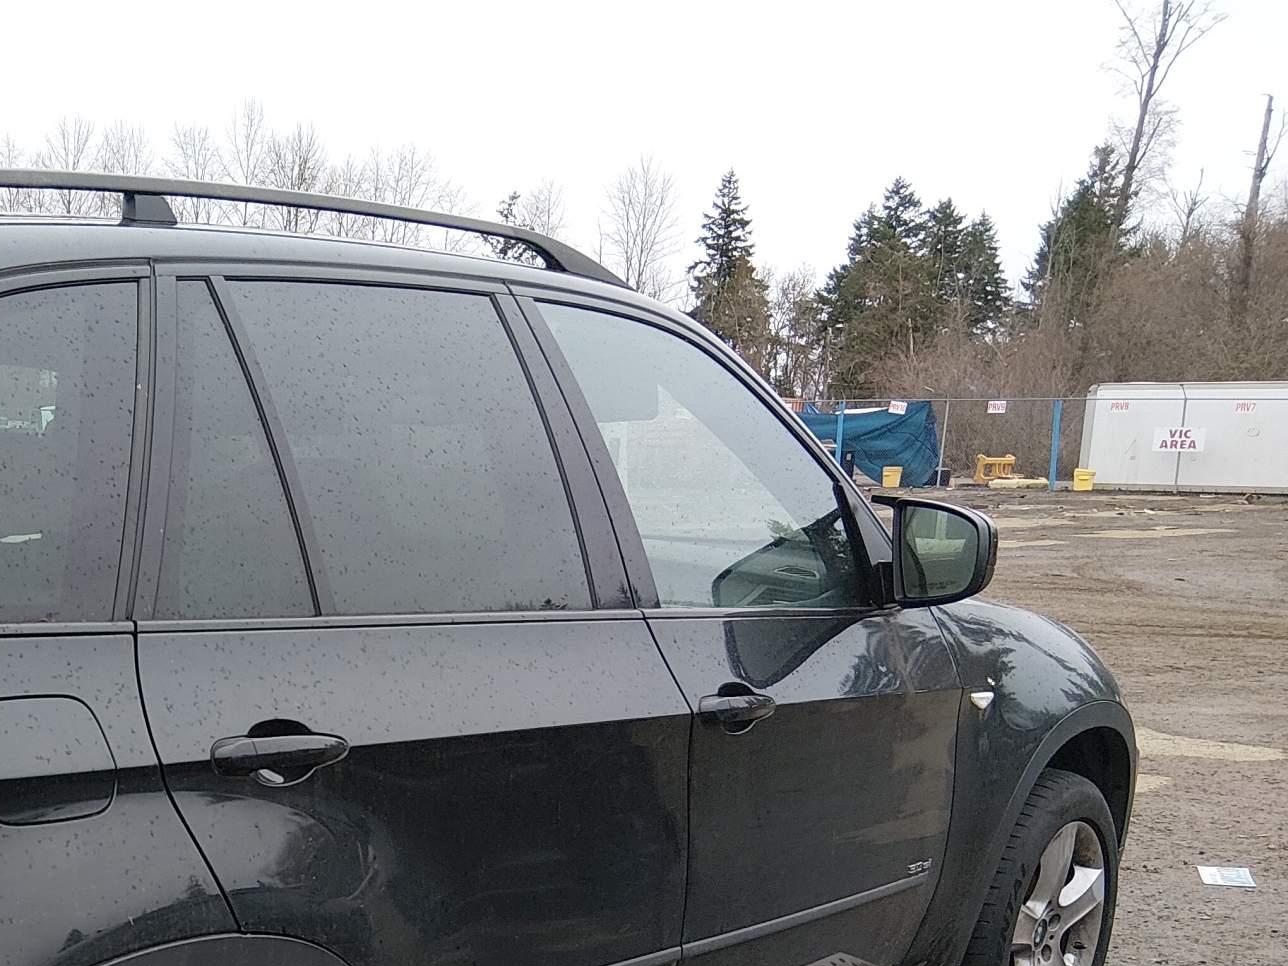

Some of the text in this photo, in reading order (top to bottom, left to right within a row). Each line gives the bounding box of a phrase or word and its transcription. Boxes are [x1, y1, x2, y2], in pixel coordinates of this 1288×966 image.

[1235, 402, 1257, 412] PRV7
[1169, 429, 1192, 439] VIC
[1159, 439, 1197, 449] AREA
